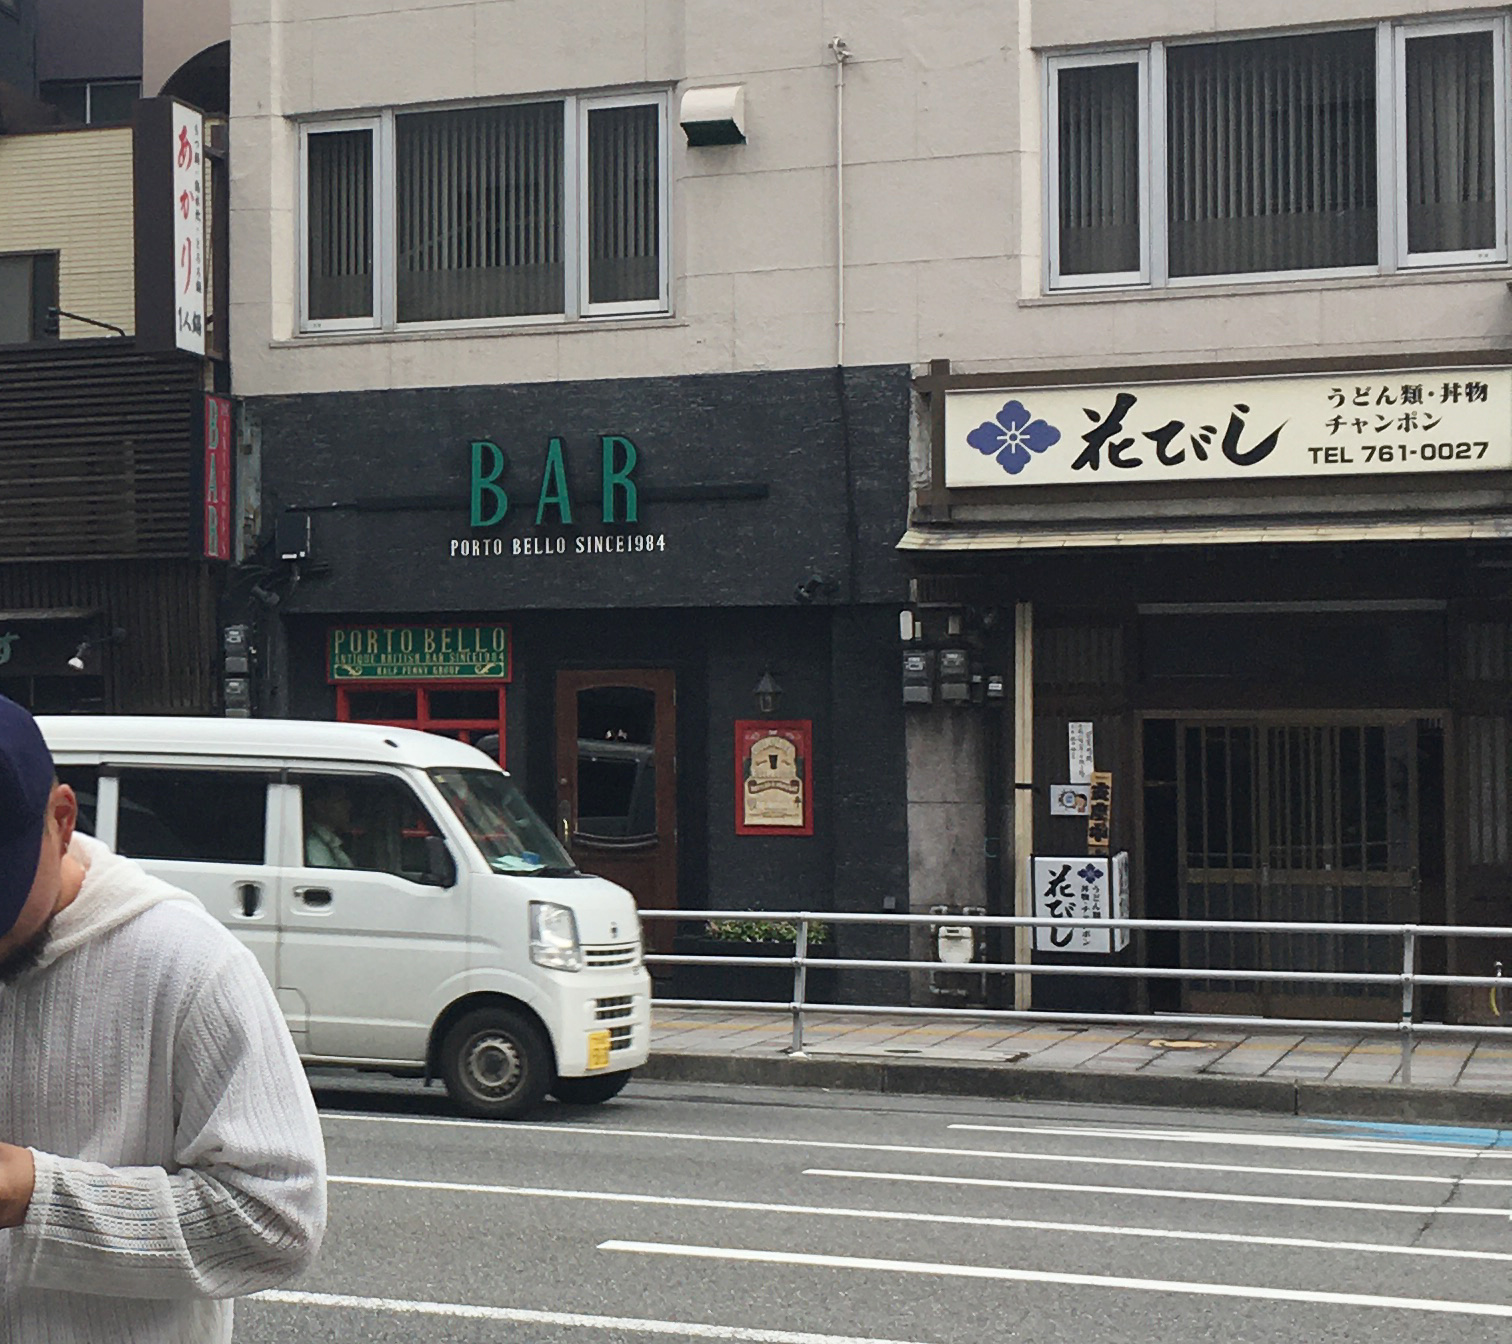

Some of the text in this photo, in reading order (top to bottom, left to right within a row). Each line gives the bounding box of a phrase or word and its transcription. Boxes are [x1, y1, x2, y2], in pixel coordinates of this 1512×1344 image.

[178, 125, 196, 294] あかり
[1071, 393, 1289, 471] 花びし
[1325, 410, 1442, 436] チャンポン
[208, 399, 219, 556] BAR
[1308, 441, 1489, 465] TEL 761-0027
[470, 436, 638, 527] BAR
[450, 538, 502, 556] PORTO
[512, 536, 566, 555] BELLO
[335, 627, 505, 654] PORTO BELLO
